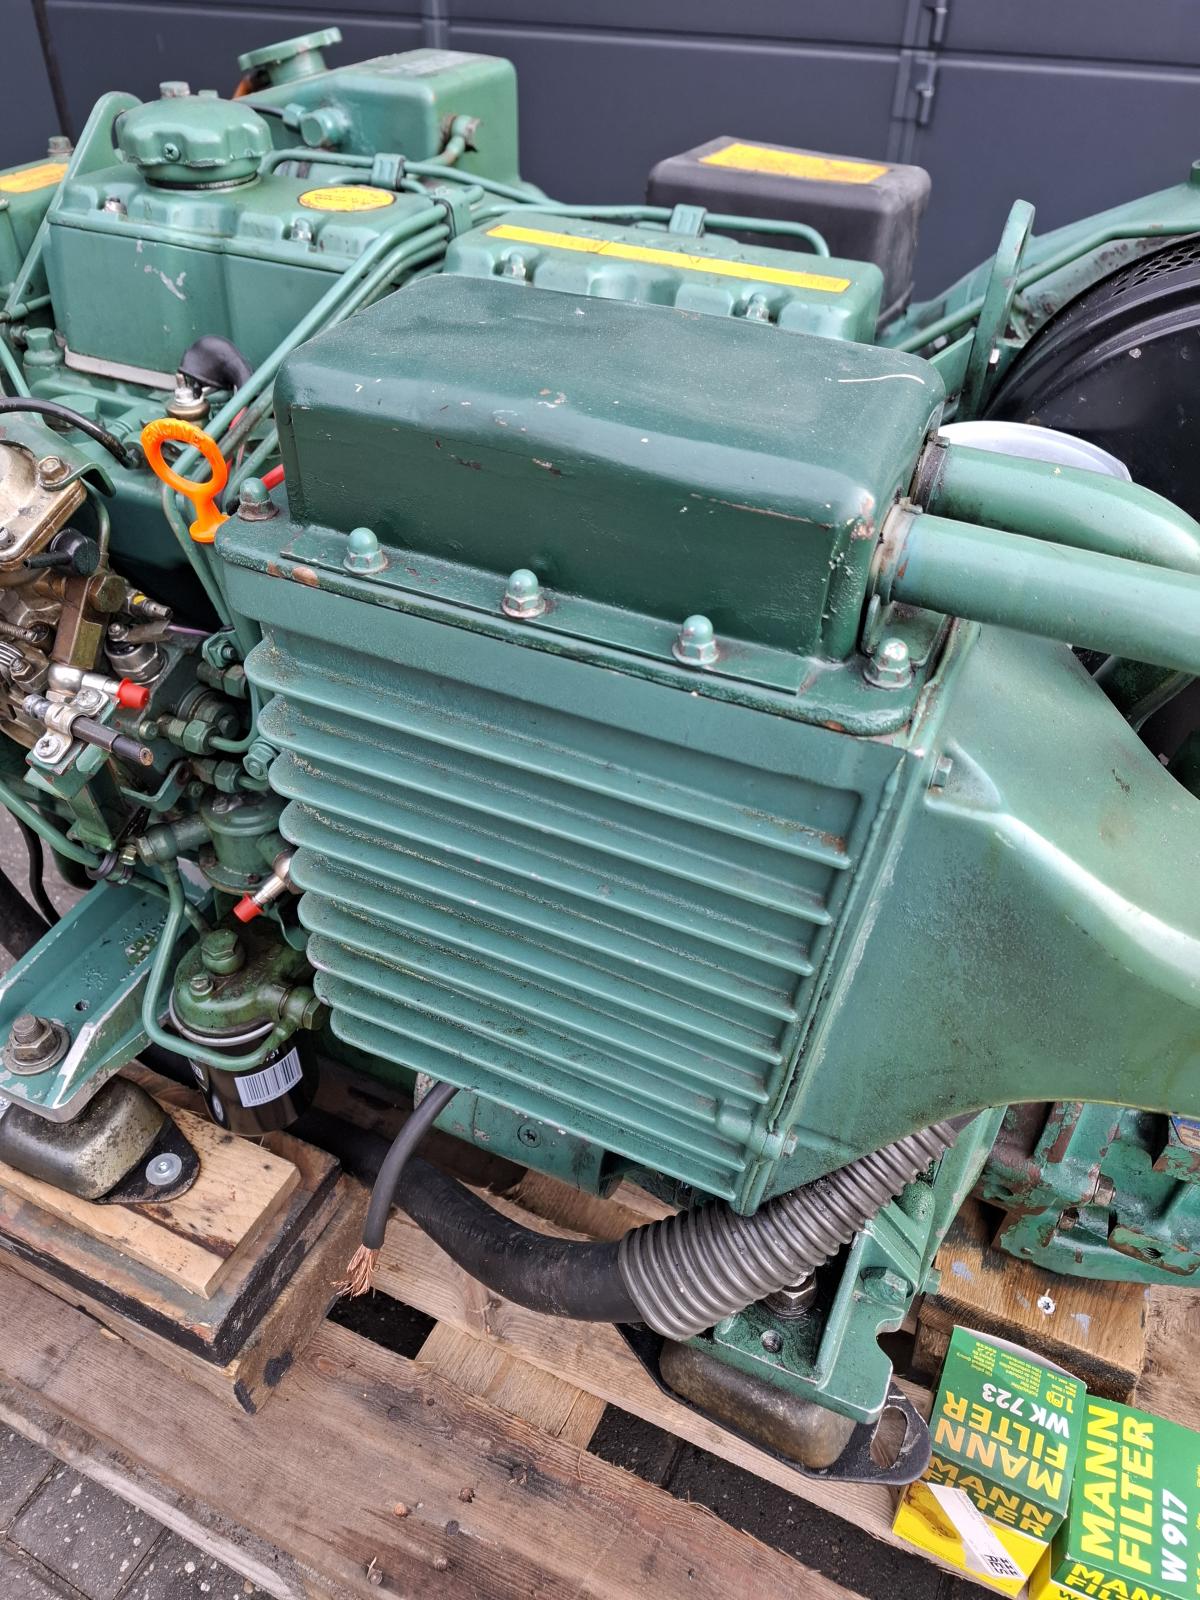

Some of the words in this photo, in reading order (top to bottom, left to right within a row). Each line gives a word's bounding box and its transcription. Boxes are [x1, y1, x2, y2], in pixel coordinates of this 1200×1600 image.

[943, 1390, 1068, 1471] FILTER
[982, 1383, 1025, 1417] 723
[1029, 1402, 1070, 1439] WK
[928, 1455, 1053, 1526] MANN
[934, 1417, 1063, 1500] MANN
[1081, 1405, 1118, 1560] MANN
[1119, 1416, 1153, 1574] FILTER
[1161, 1488, 1188, 1547] 917
[1161, 1547, 1188, 1583] W
